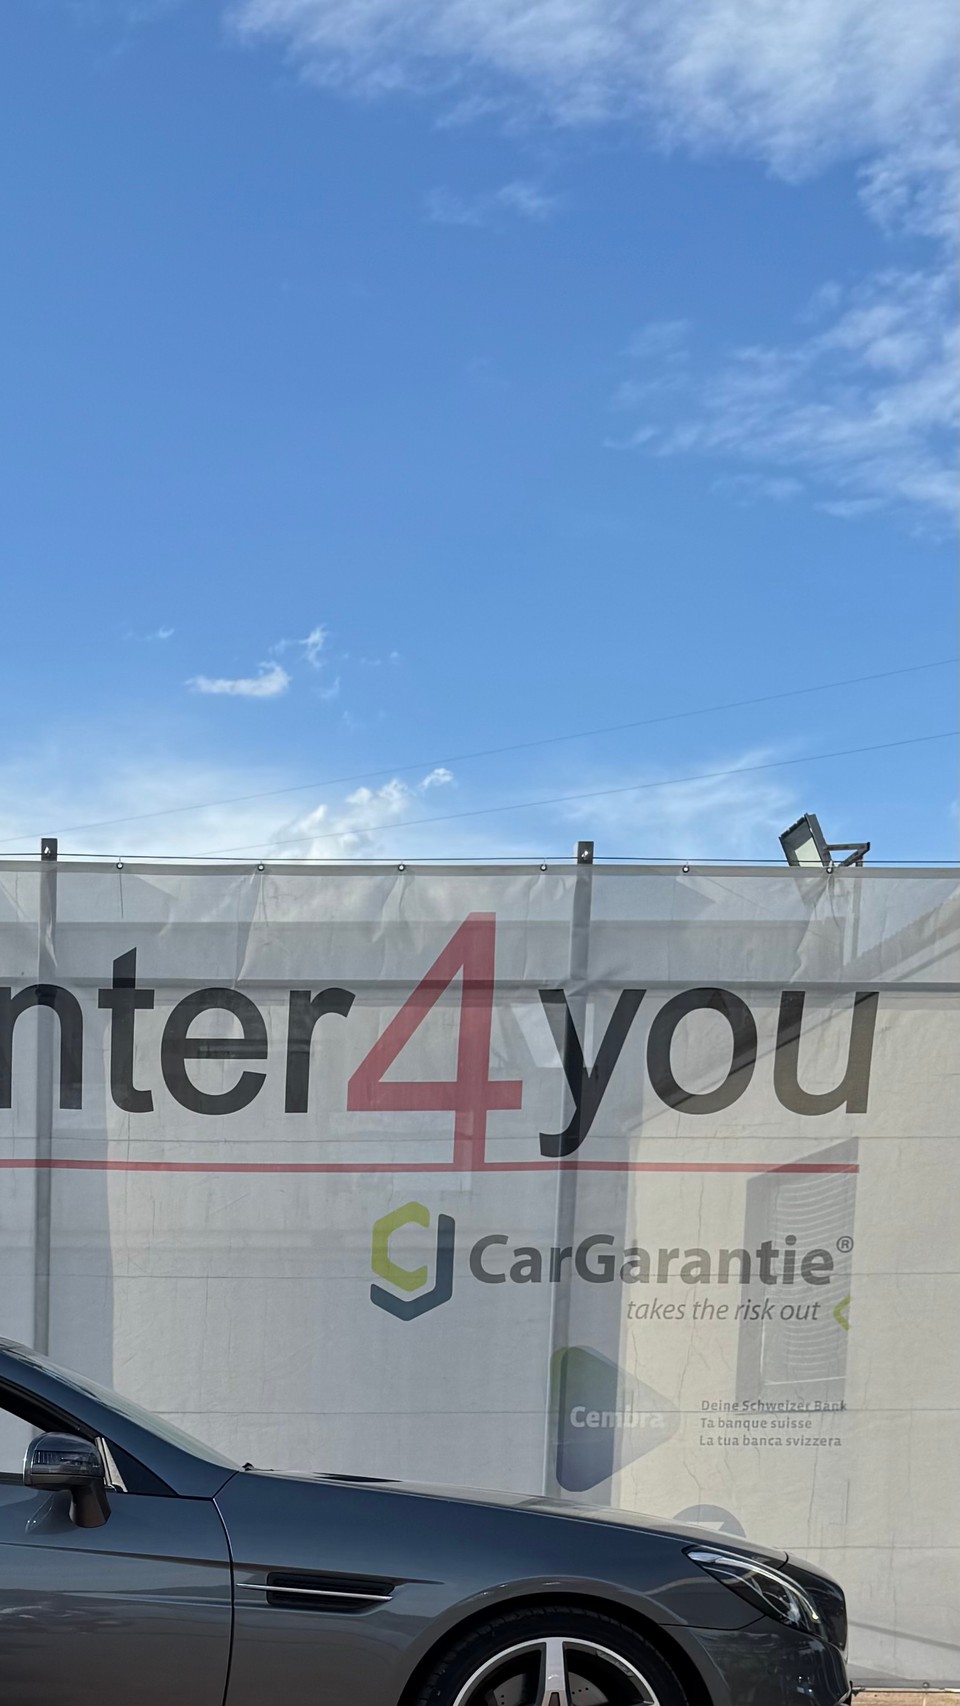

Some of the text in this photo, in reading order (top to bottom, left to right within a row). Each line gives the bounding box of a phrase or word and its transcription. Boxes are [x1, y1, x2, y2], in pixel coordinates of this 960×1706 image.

[626, 1298, 821, 1321] takes the risk out
[701, 1400, 848, 1412] Deine Schweizer Bank
[569, 1405, 666, 1429] Cembra
[700, 1417, 813, 1431] Ta banque suisse
[699, 1435, 842, 1447] La tua banca svizzera
